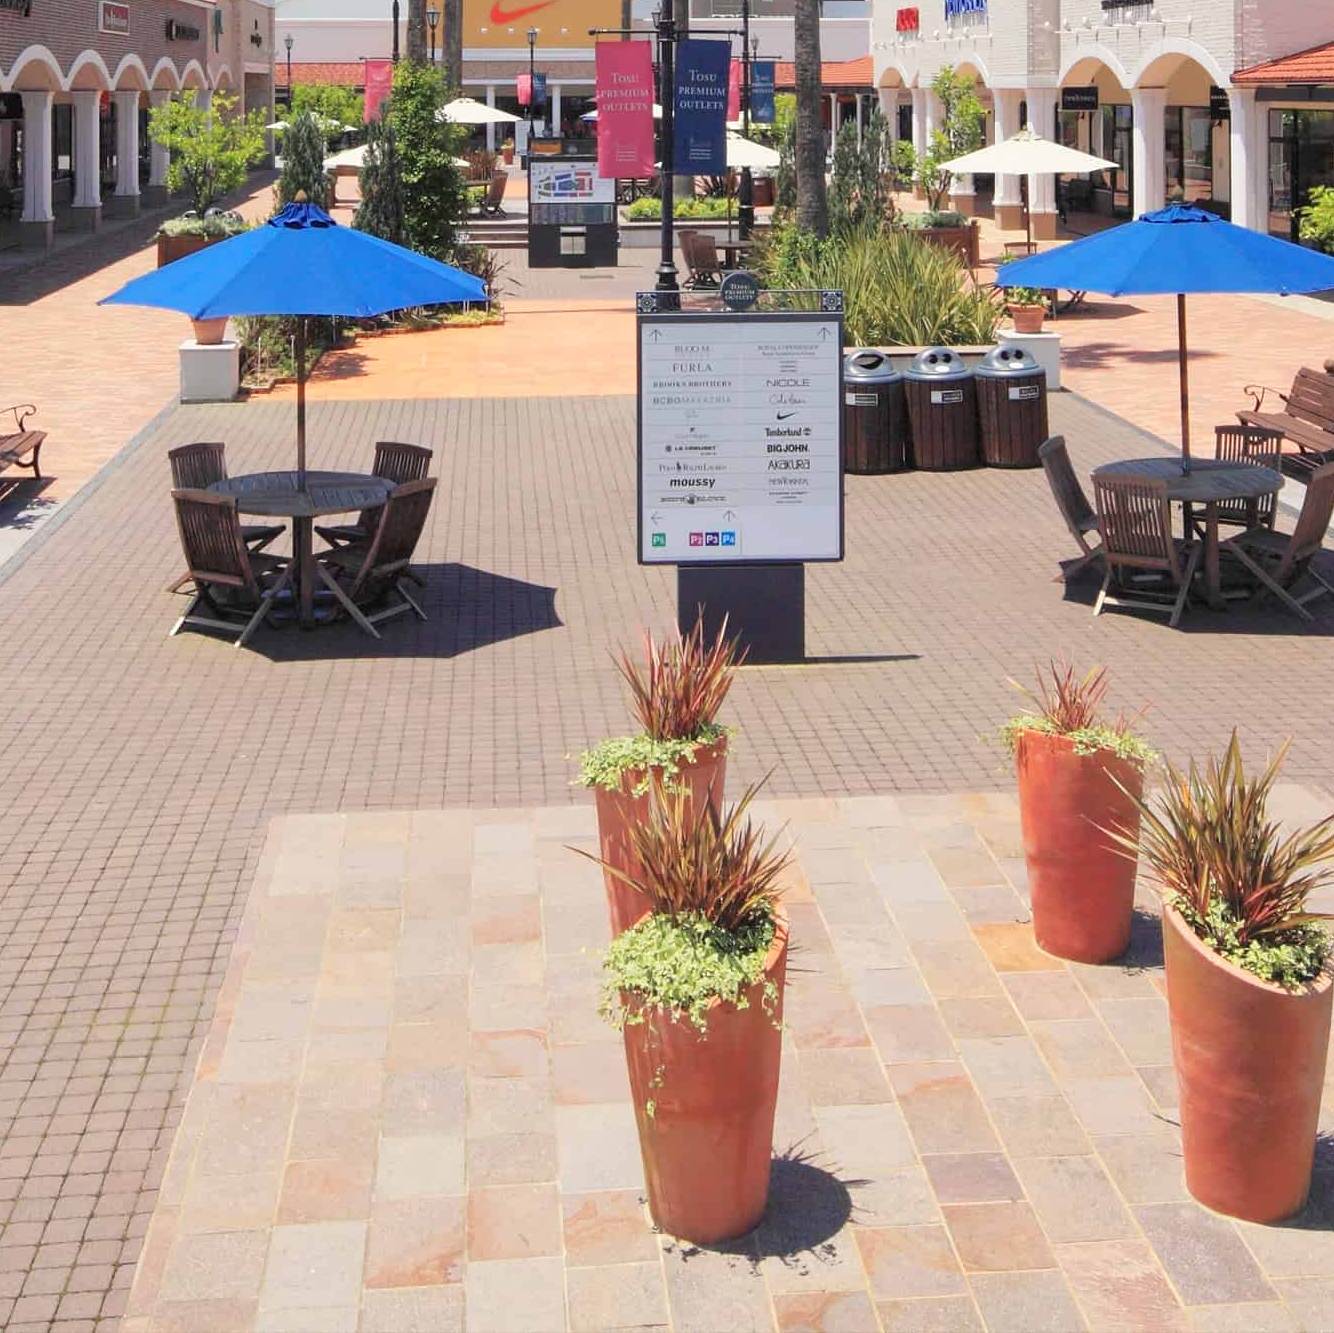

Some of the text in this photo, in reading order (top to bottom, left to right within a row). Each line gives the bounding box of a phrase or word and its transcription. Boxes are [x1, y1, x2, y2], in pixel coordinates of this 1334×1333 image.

[600, 89, 650, 98] PREMIUM
[678, 86, 726, 97] PREMIUM
[601, 102, 648, 112] OUTLETS
[678, 100, 724, 110] OUTLETS
[672, 363, 713, 372] FURLA
[670, 478, 716, 489] moussy
